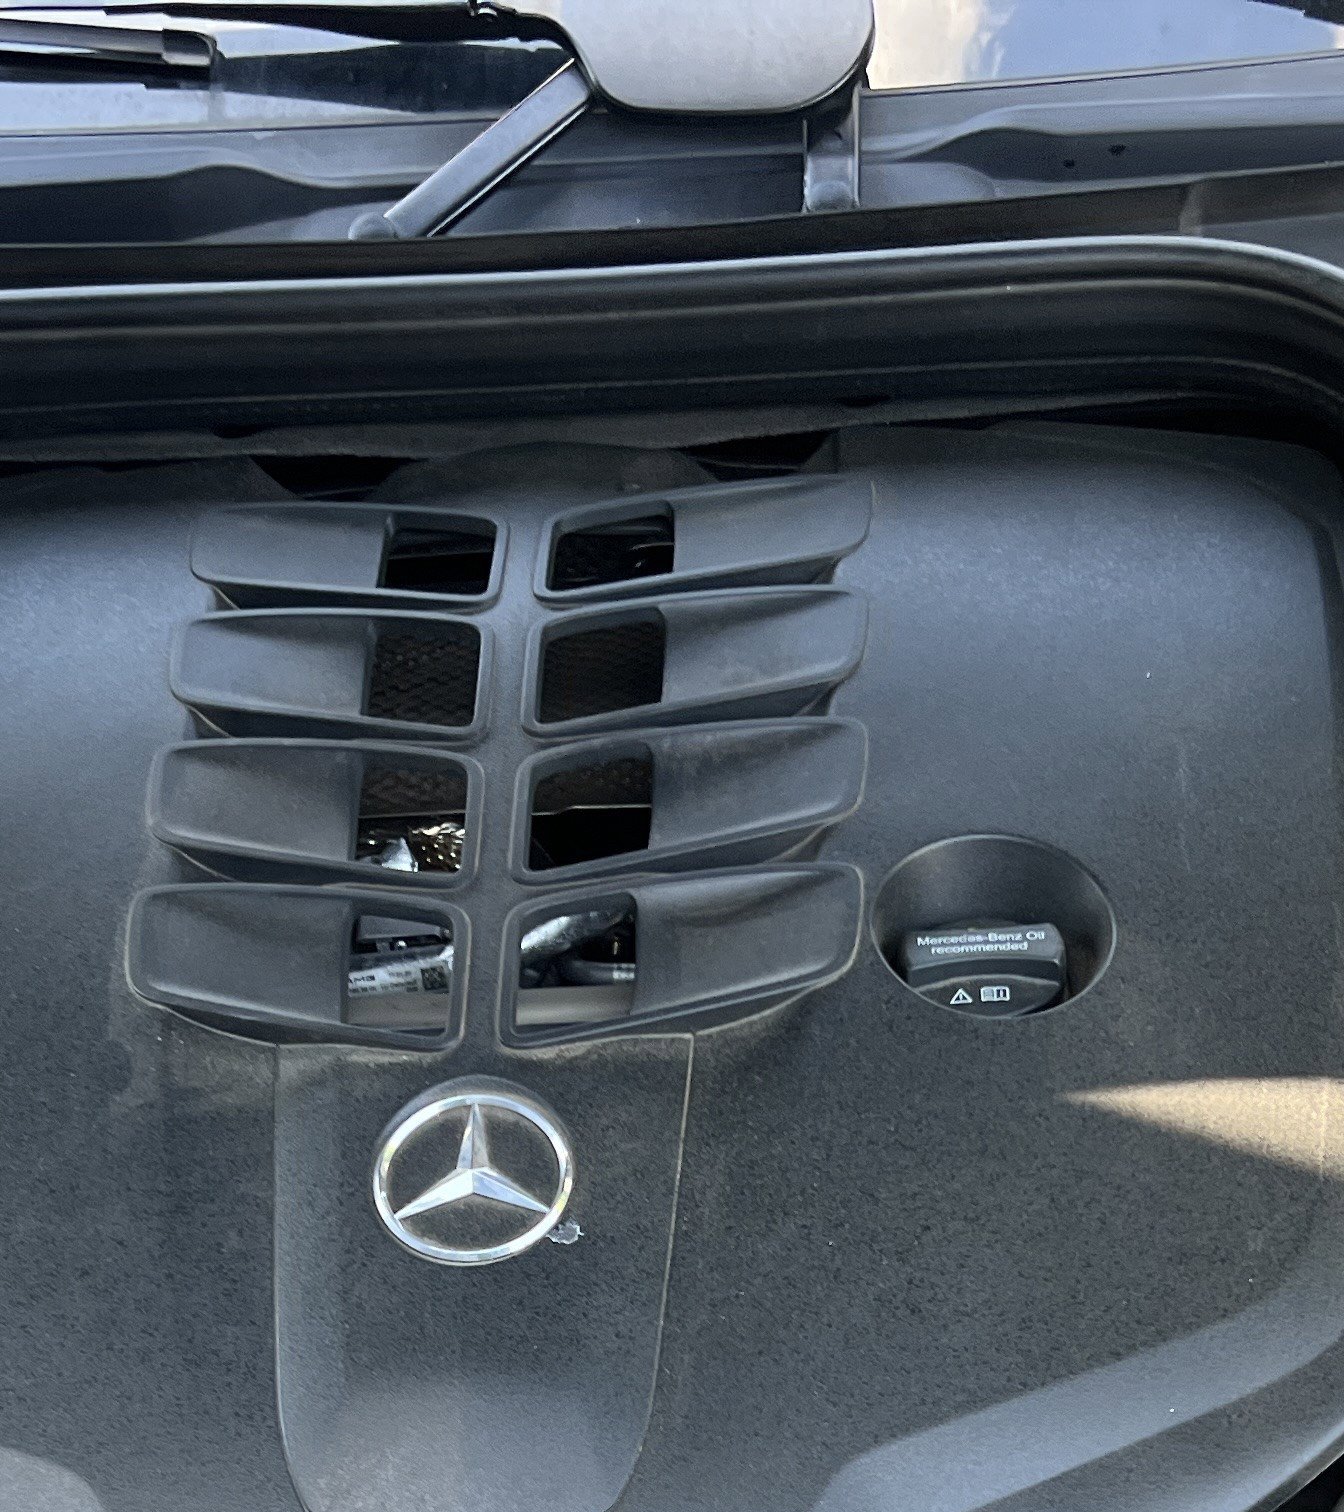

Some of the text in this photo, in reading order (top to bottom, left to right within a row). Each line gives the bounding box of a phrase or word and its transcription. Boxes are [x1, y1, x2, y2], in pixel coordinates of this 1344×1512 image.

[917, 930, 1045, 946] Mercedes-Benz Oil
[931, 941, 1028, 955] recommended
